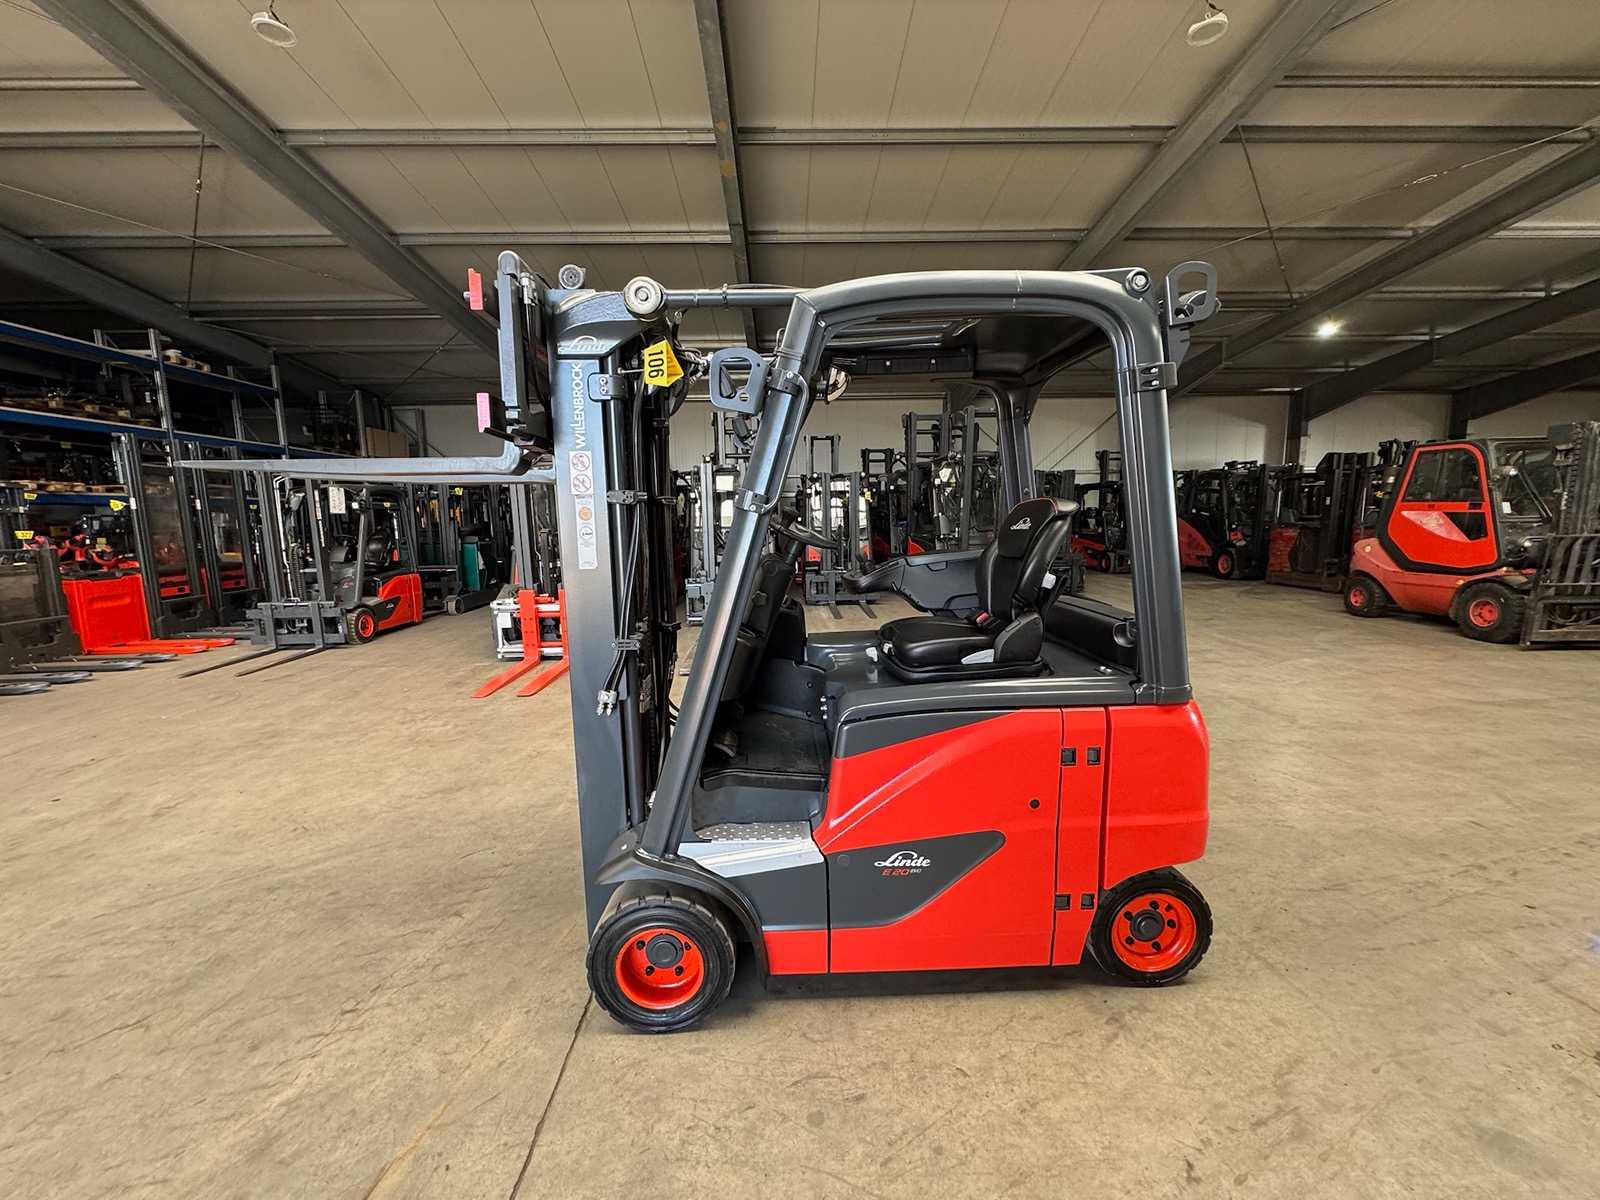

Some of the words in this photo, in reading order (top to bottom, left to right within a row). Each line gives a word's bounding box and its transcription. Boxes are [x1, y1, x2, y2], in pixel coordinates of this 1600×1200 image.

[558, 336, 608, 353] Linde
[648, 350, 664, 379] 106
[570, 363, 587, 450] WILLENBROCK
[874, 850, 931, 867] Linde
[892, 868, 909, 876] 20
